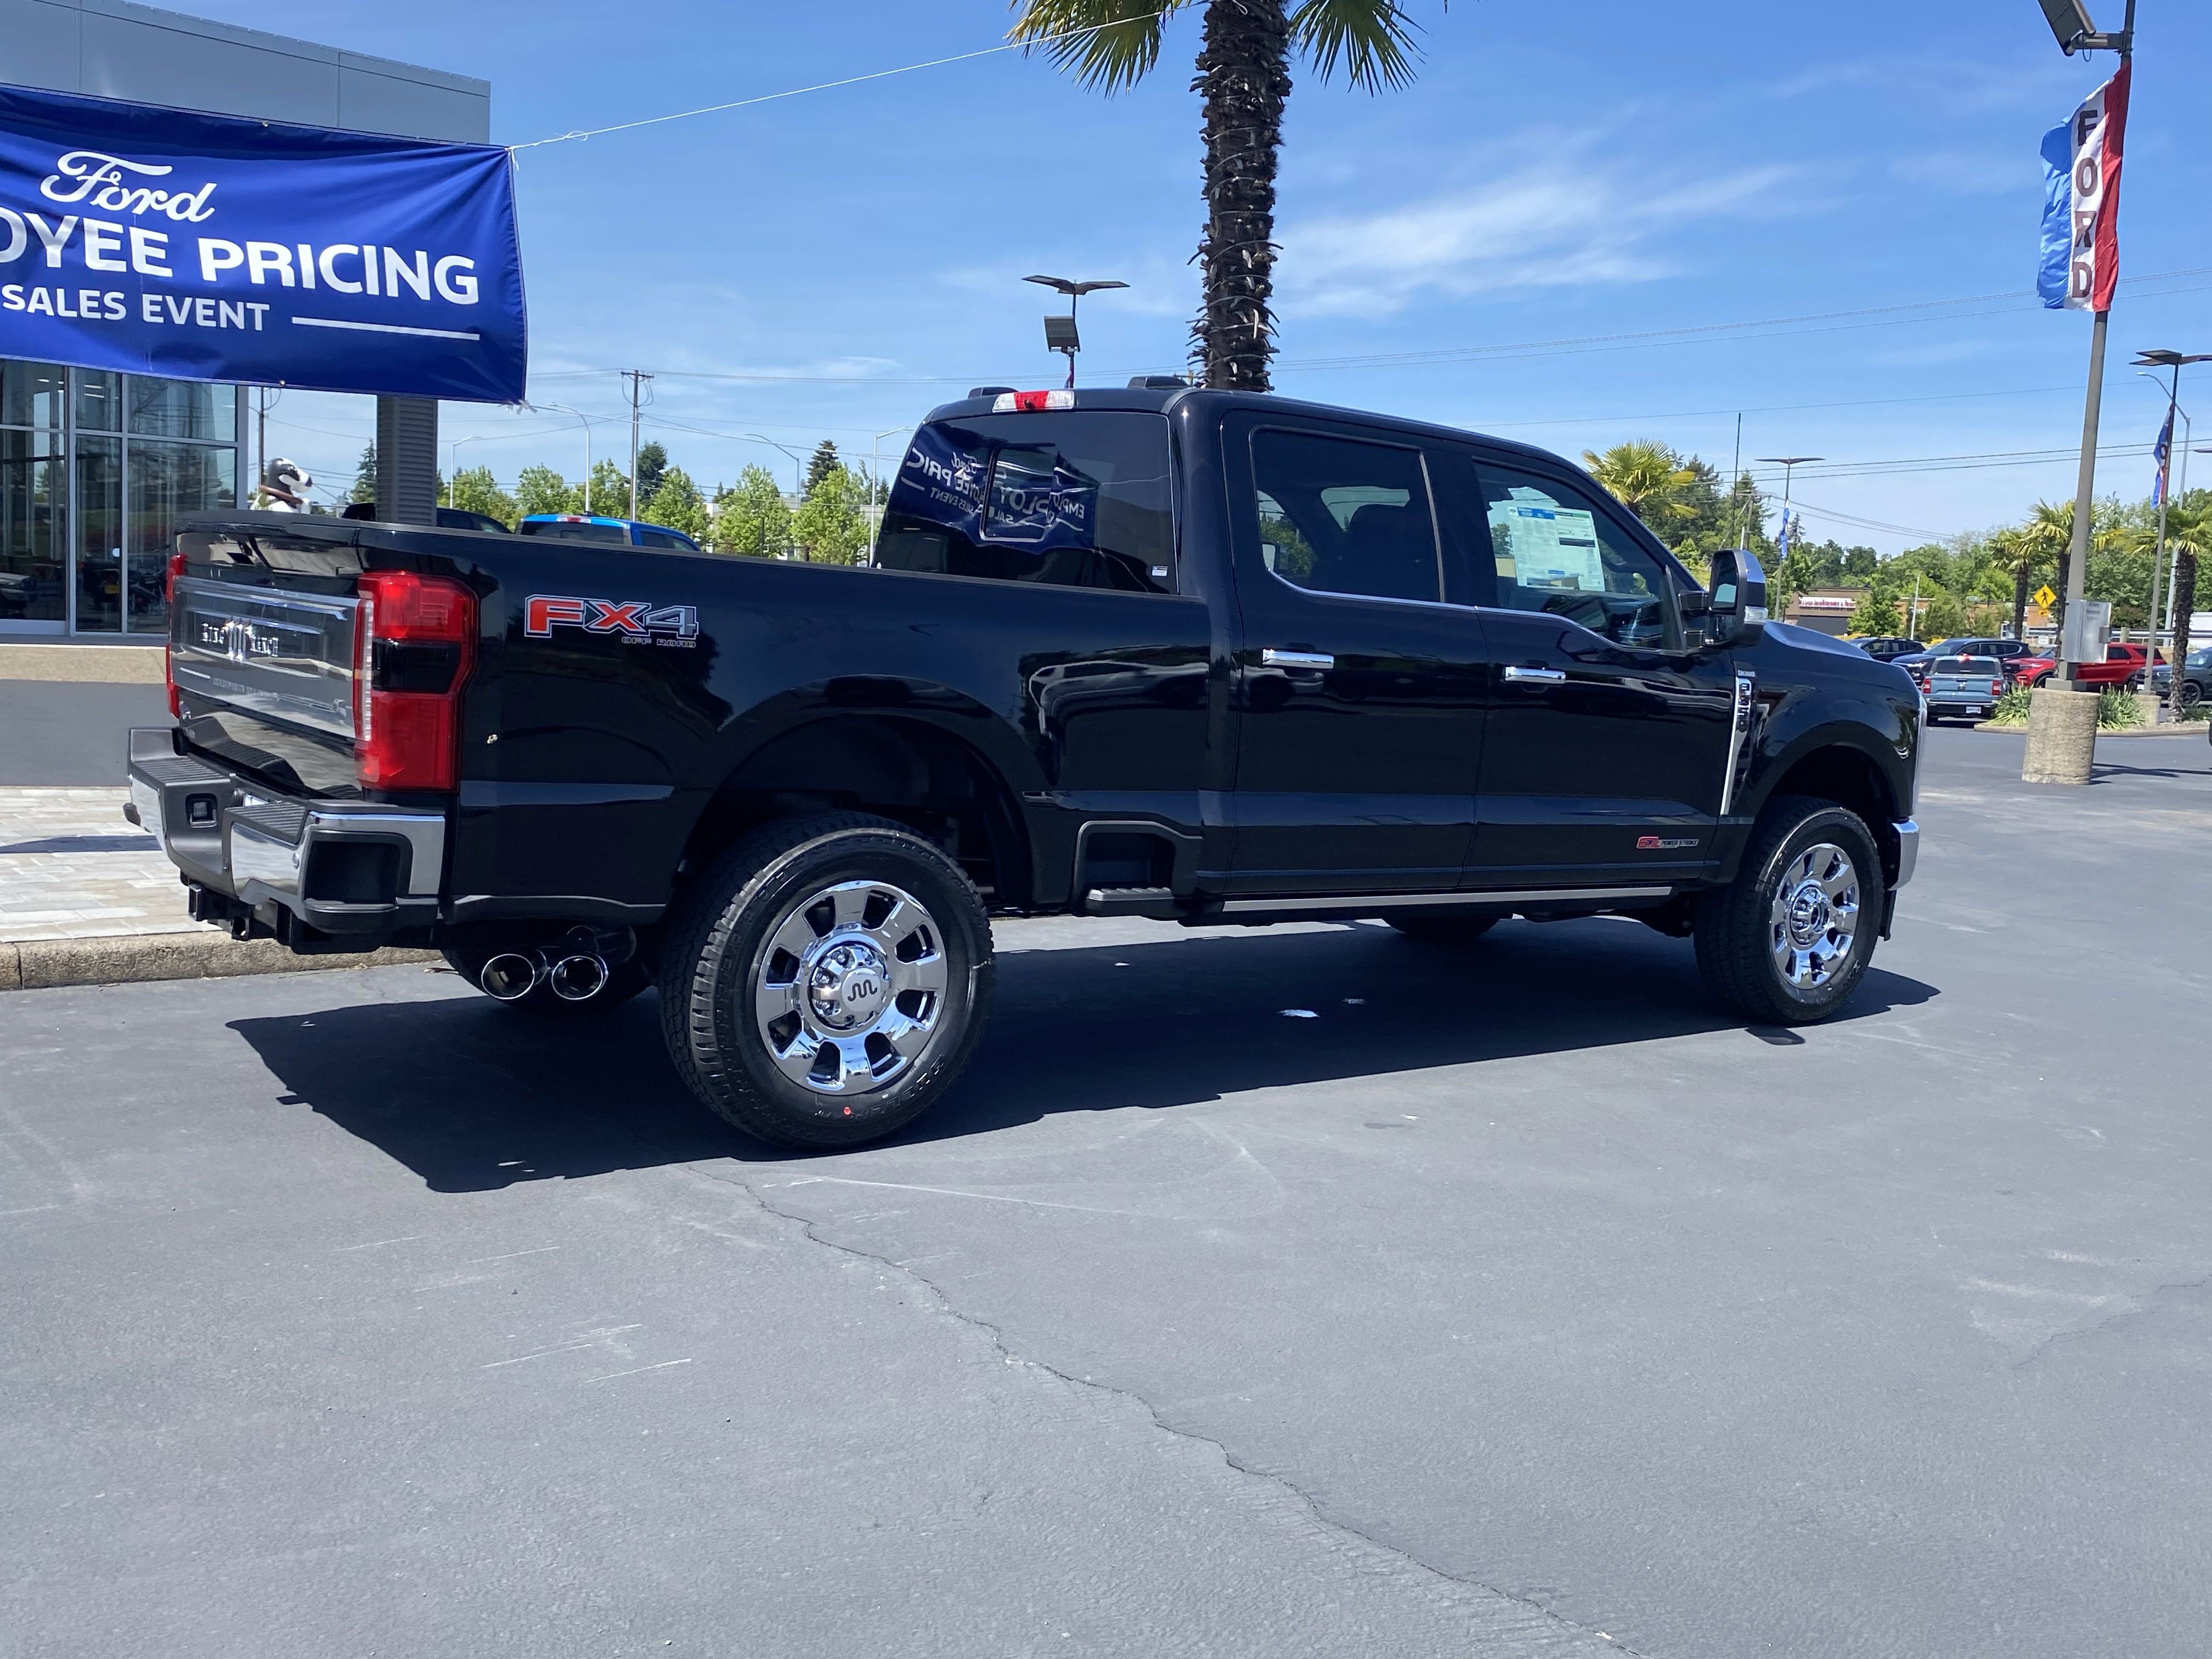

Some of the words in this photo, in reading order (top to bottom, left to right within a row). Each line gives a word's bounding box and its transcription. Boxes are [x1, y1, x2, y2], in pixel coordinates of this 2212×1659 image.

[40, 151, 217, 223] Ford
[2072, 109, 2098, 298] FORD
[198, 237, 479, 305] PRICING
[1, 284, 127, 321] SALES
[142, 293, 270, 331] EVENT
[524, 594, 699, 640] FX4
[621, 636, 652, 645] OFF
[656, 638, 697, 648] ROAD
